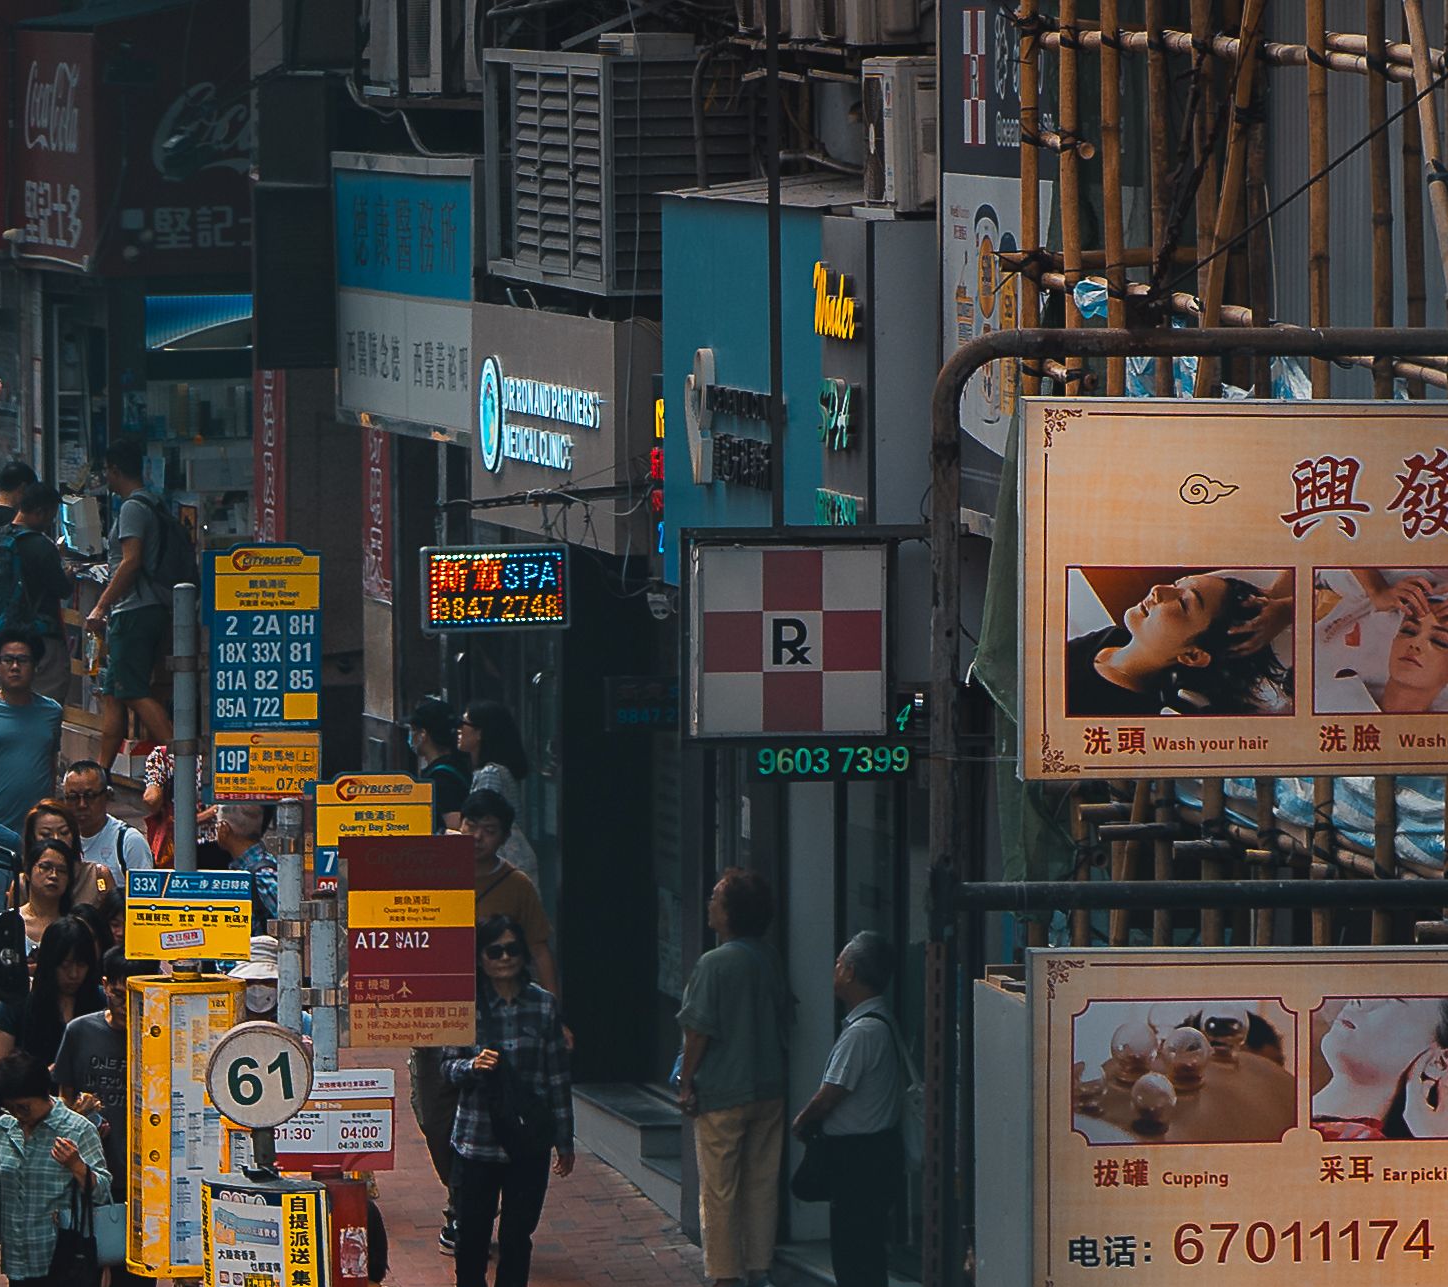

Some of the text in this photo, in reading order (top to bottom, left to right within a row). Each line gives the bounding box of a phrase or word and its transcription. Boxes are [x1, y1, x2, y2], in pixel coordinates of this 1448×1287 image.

[551, 384, 595, 428] PARTNERS
[504, 561, 555, 589] SPA
[235, 590, 299, 599] Quarry Bay Street
[439, 594, 558, 619] 9847 2748
[226, 615, 314, 635] 2 2A 8H
[218, 642, 311, 663] 18X 33X 81
[217, 669, 313, 690] 81A 82 85
[217, 698, 280, 718] 85A 722
[1083, 726, 1269, 755] 洗頭 Wash your hair
[1319, 724, 1447, 753] 洗臉 Wash
[219, 750, 247, 771] 19P
[758, 746, 909, 774] 9603 7399
[347, 784, 392, 794] CITYBUS
[339, 823, 409, 833] Quarry Bay Street
[133, 878, 158, 891] 33X
[355, 932, 390, 949] A12
[368, 978, 391, 990] 機場
[366, 993, 395, 1002] Airport
[367, 1020, 441, 1030] HK-Zhuhai-Macao
[442, 1021, 470, 1031] Bridge
[367, 1032, 434, 1042] Hong Kong Port
[227, 1051, 295, 1106] 61
[363, 1141, 384, 1149] 05:00
[1094, 1159, 1229, 1188] 拔罐 Cupping
[1319, 1155, 1374, 1183] 采耳
[1383, 1167, 1407, 1181] Ear
[289, 1196, 311, 1265] 自提派送
[1173, 1218, 1435, 1265] 67011174
